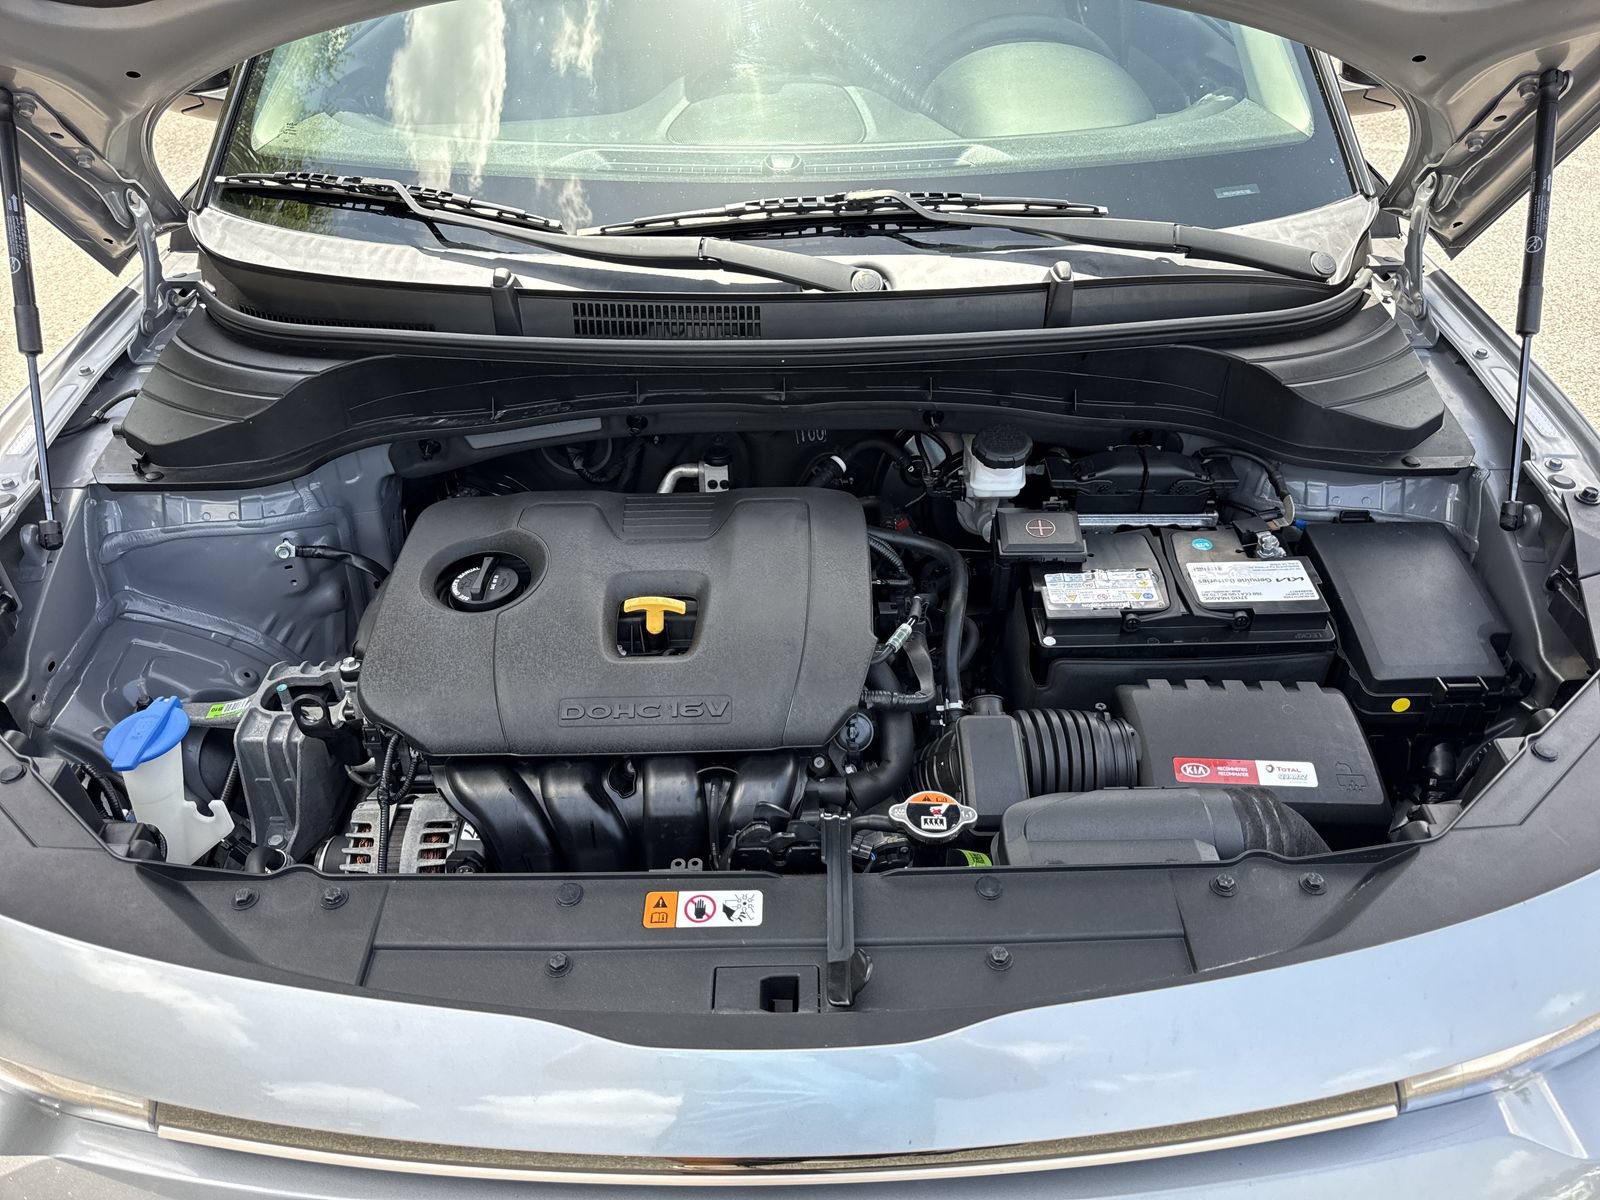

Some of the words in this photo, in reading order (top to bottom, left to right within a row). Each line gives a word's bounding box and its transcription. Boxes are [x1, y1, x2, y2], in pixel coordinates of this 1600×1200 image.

[561, 703, 661, 720] DOHC
[671, 701, 729, 718] 16V
[961, 810, 973, 818] 1.1
